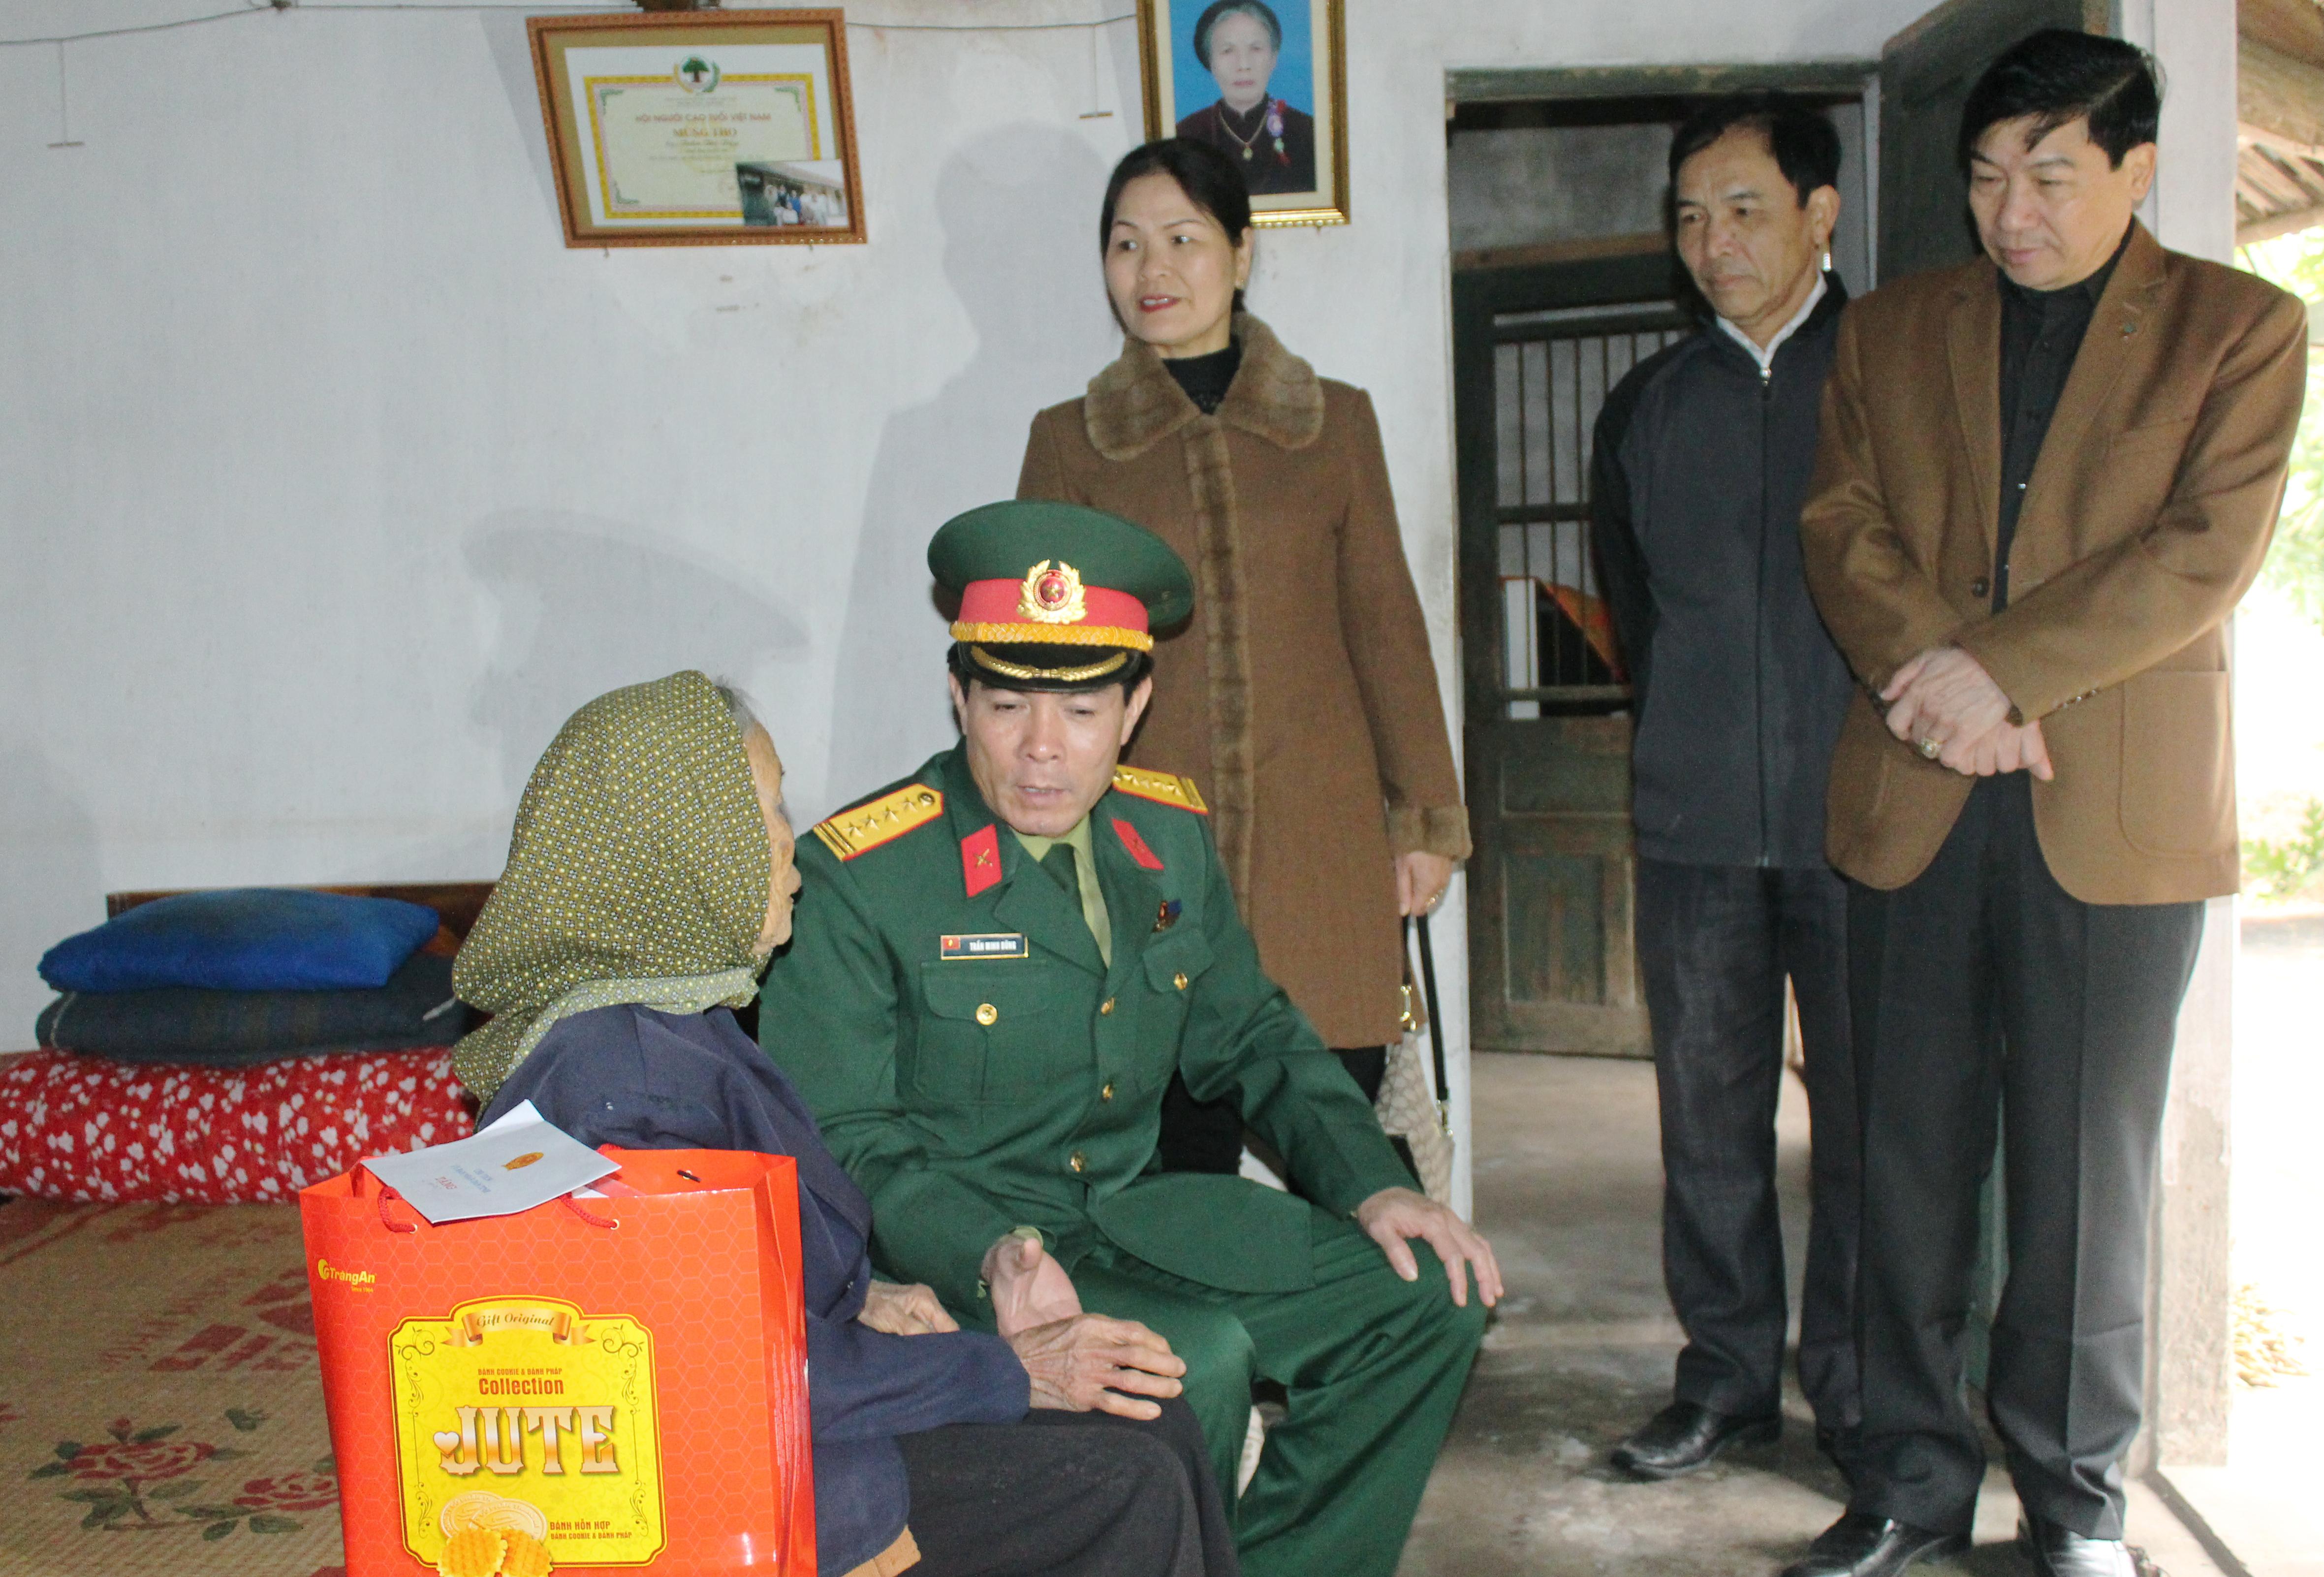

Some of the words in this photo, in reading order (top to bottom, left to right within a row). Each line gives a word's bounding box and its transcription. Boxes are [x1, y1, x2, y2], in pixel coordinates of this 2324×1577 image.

[476, 1314, 500, 1327] Gift
[504, 1313, 555, 1326] Original
[478, 1367, 495, 1375] BÁNH
[479, 1378, 564, 1395] Collection
[433, 1405, 620, 1476] JUTE
[550, 1520, 571, 1530] BÁNH
[594, 1520, 610, 1532] HỢP
